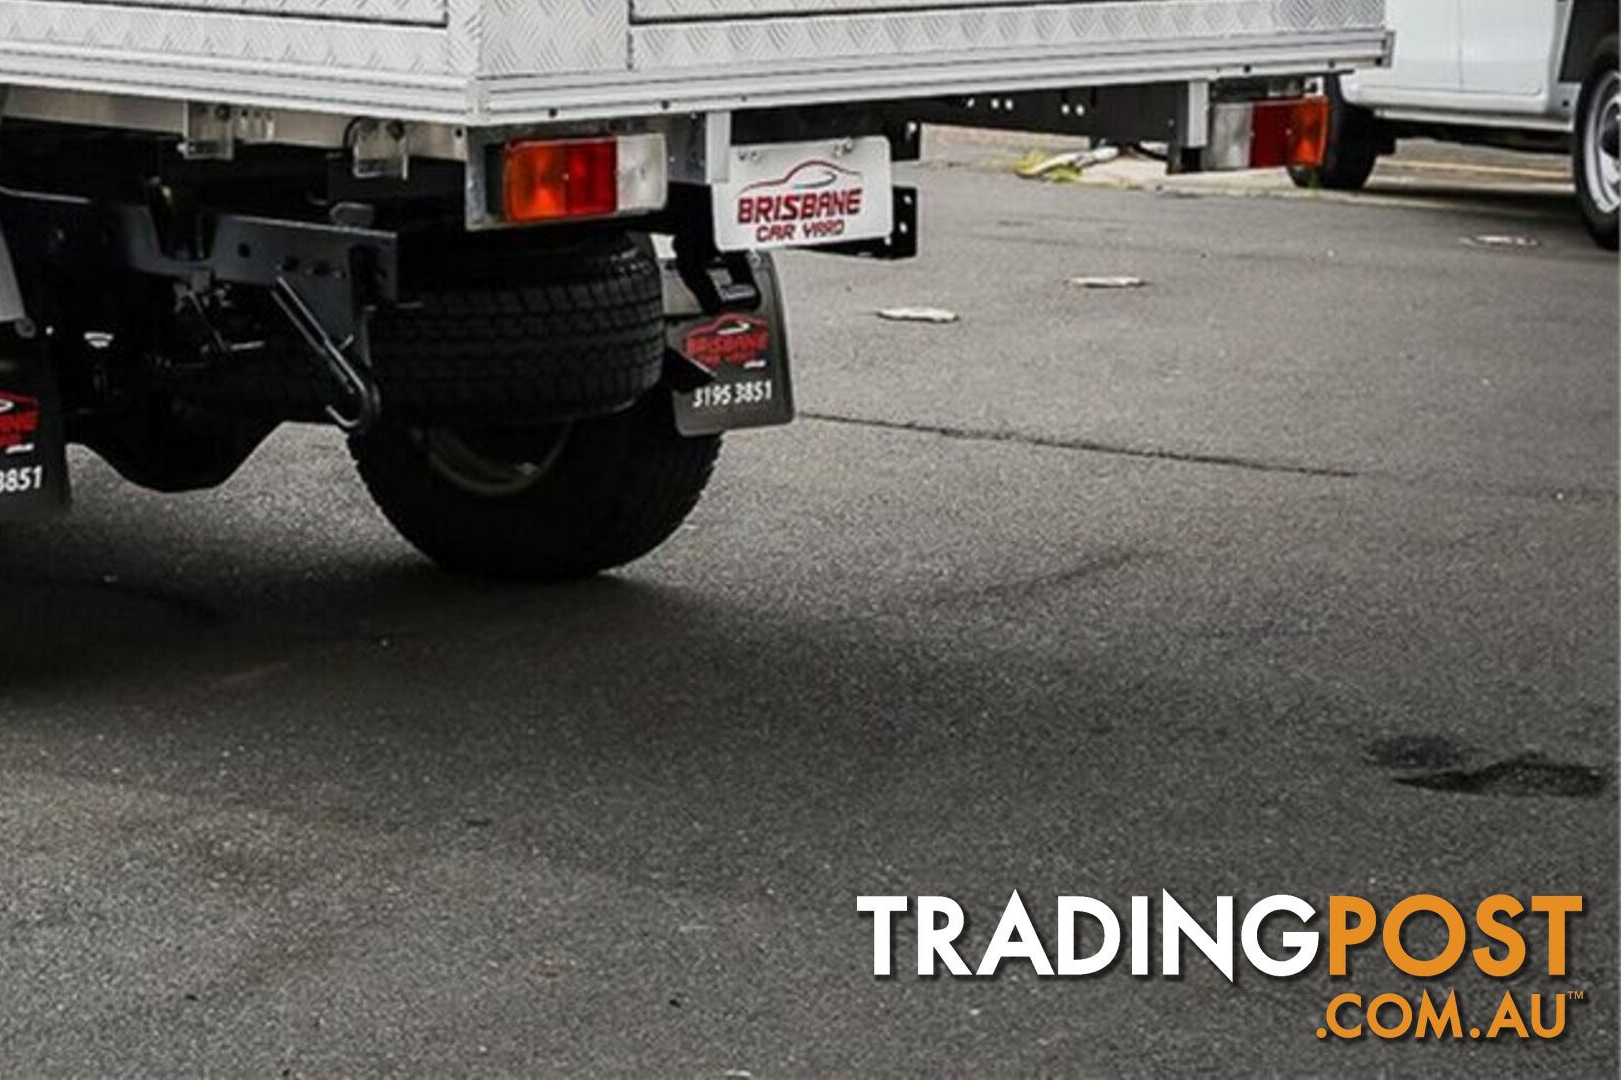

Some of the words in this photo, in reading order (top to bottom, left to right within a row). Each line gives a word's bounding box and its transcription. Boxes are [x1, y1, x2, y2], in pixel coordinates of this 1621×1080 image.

[737, 188, 863, 224] BRISBANE
[756, 224, 796, 243] CAR
[802, 220, 845, 238] YARD
[692, 384, 732, 408] 3195
[734, 380, 772, 404] 3851
